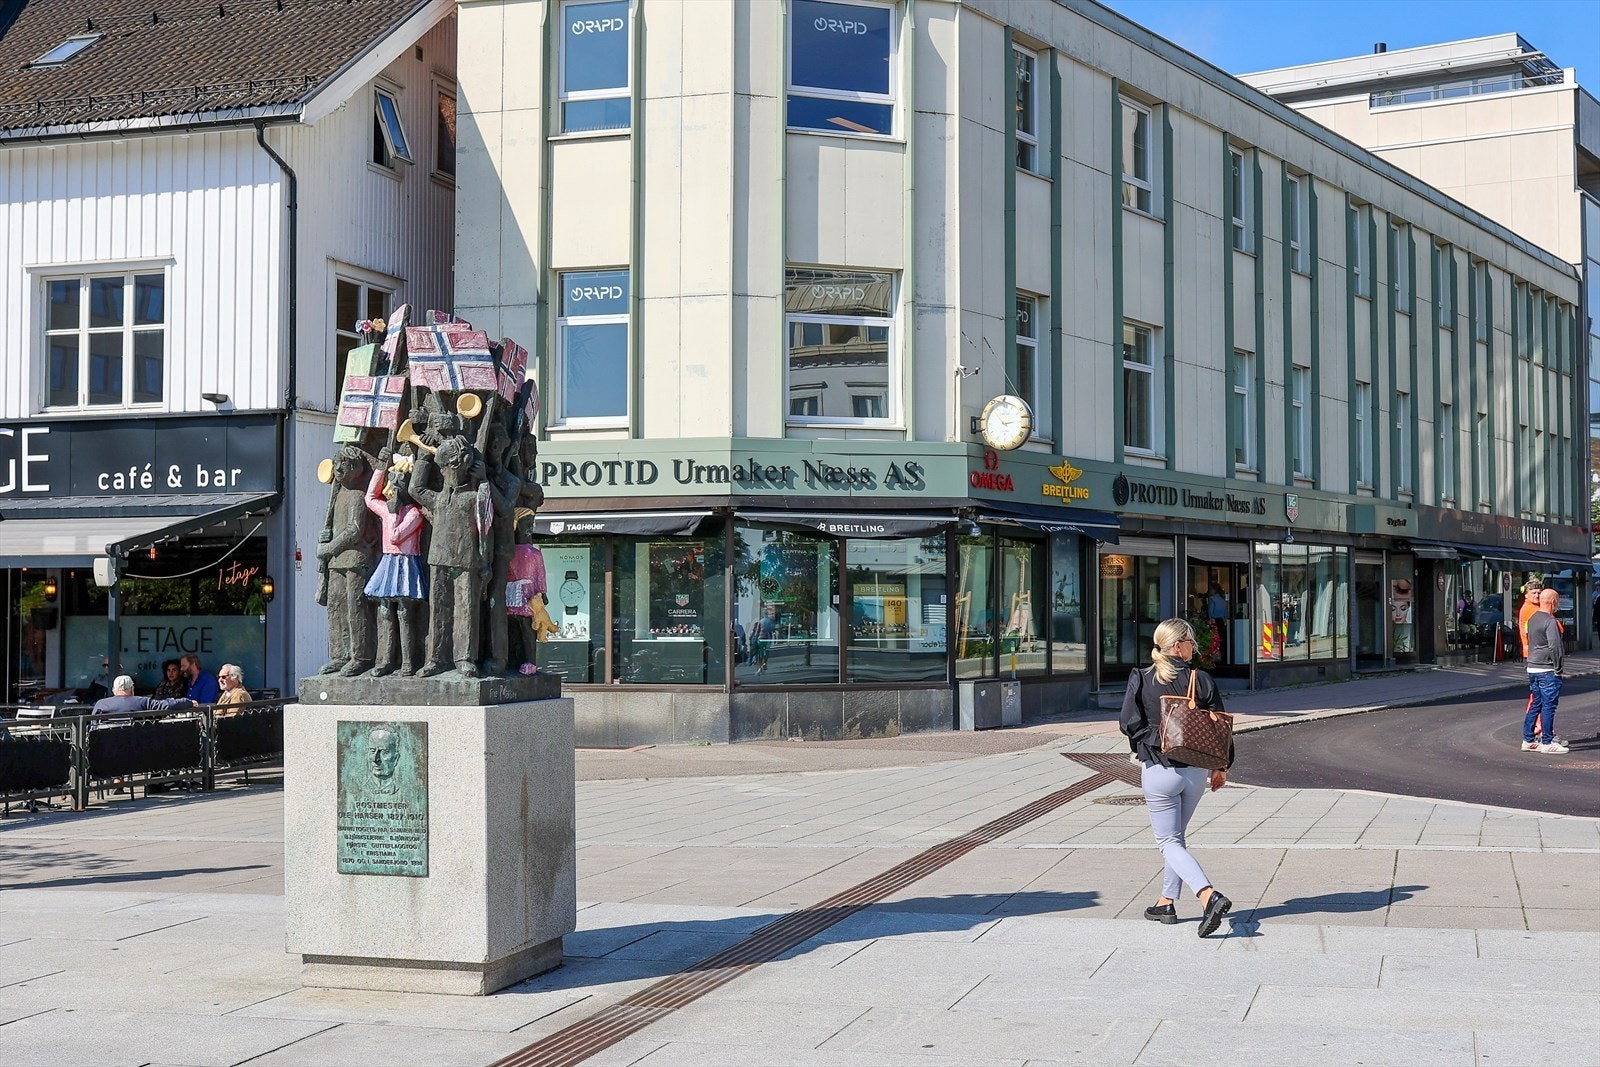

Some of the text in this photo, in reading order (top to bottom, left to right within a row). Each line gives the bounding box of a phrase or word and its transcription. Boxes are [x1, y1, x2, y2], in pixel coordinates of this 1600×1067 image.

[97, 462, 153, 490] café
[166, 464, 183, 489] &
[196, 463, 242, 488] bar
[540, 458, 920, 486] PROTID Urmaker Næss AS
[970, 471, 1015, 492] OMEGA
[1042, 484, 1089, 499] BREITLING
[1130, 482, 1266, 515] PROTID Urmaker Næss AS
[829, 524, 885, 533] BREITLING
[137, 626, 213, 654] ETAGE
[137, 660, 157, 670] café
[354, 812, 384, 820] HANSEN
